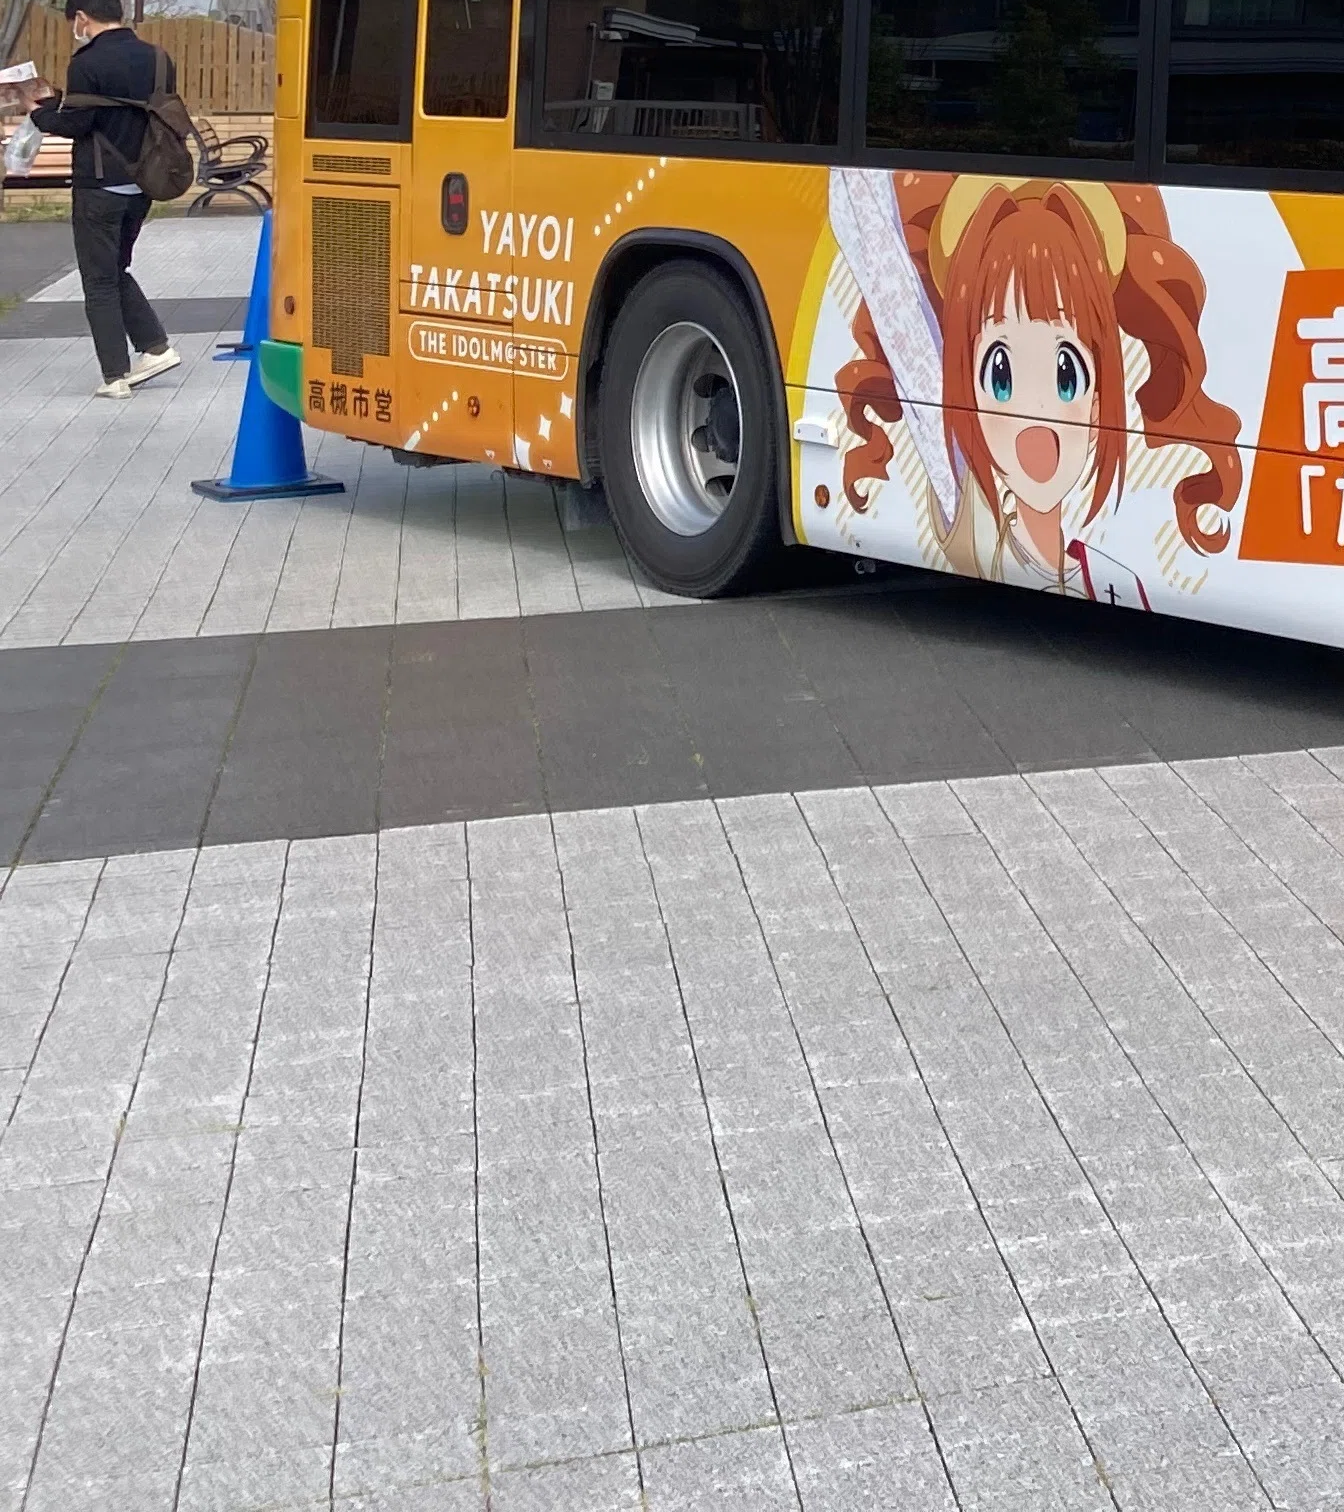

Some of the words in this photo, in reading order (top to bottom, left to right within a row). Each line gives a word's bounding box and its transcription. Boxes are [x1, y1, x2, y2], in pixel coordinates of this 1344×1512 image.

[481, 210, 574, 262] YAYOI
[410, 265, 574, 326] TAKATSUKI
[419, 330, 446, 355] THE
[452, 334, 557, 371] IDOLM@STER
[309, 378, 392, 423] 高槻市営
